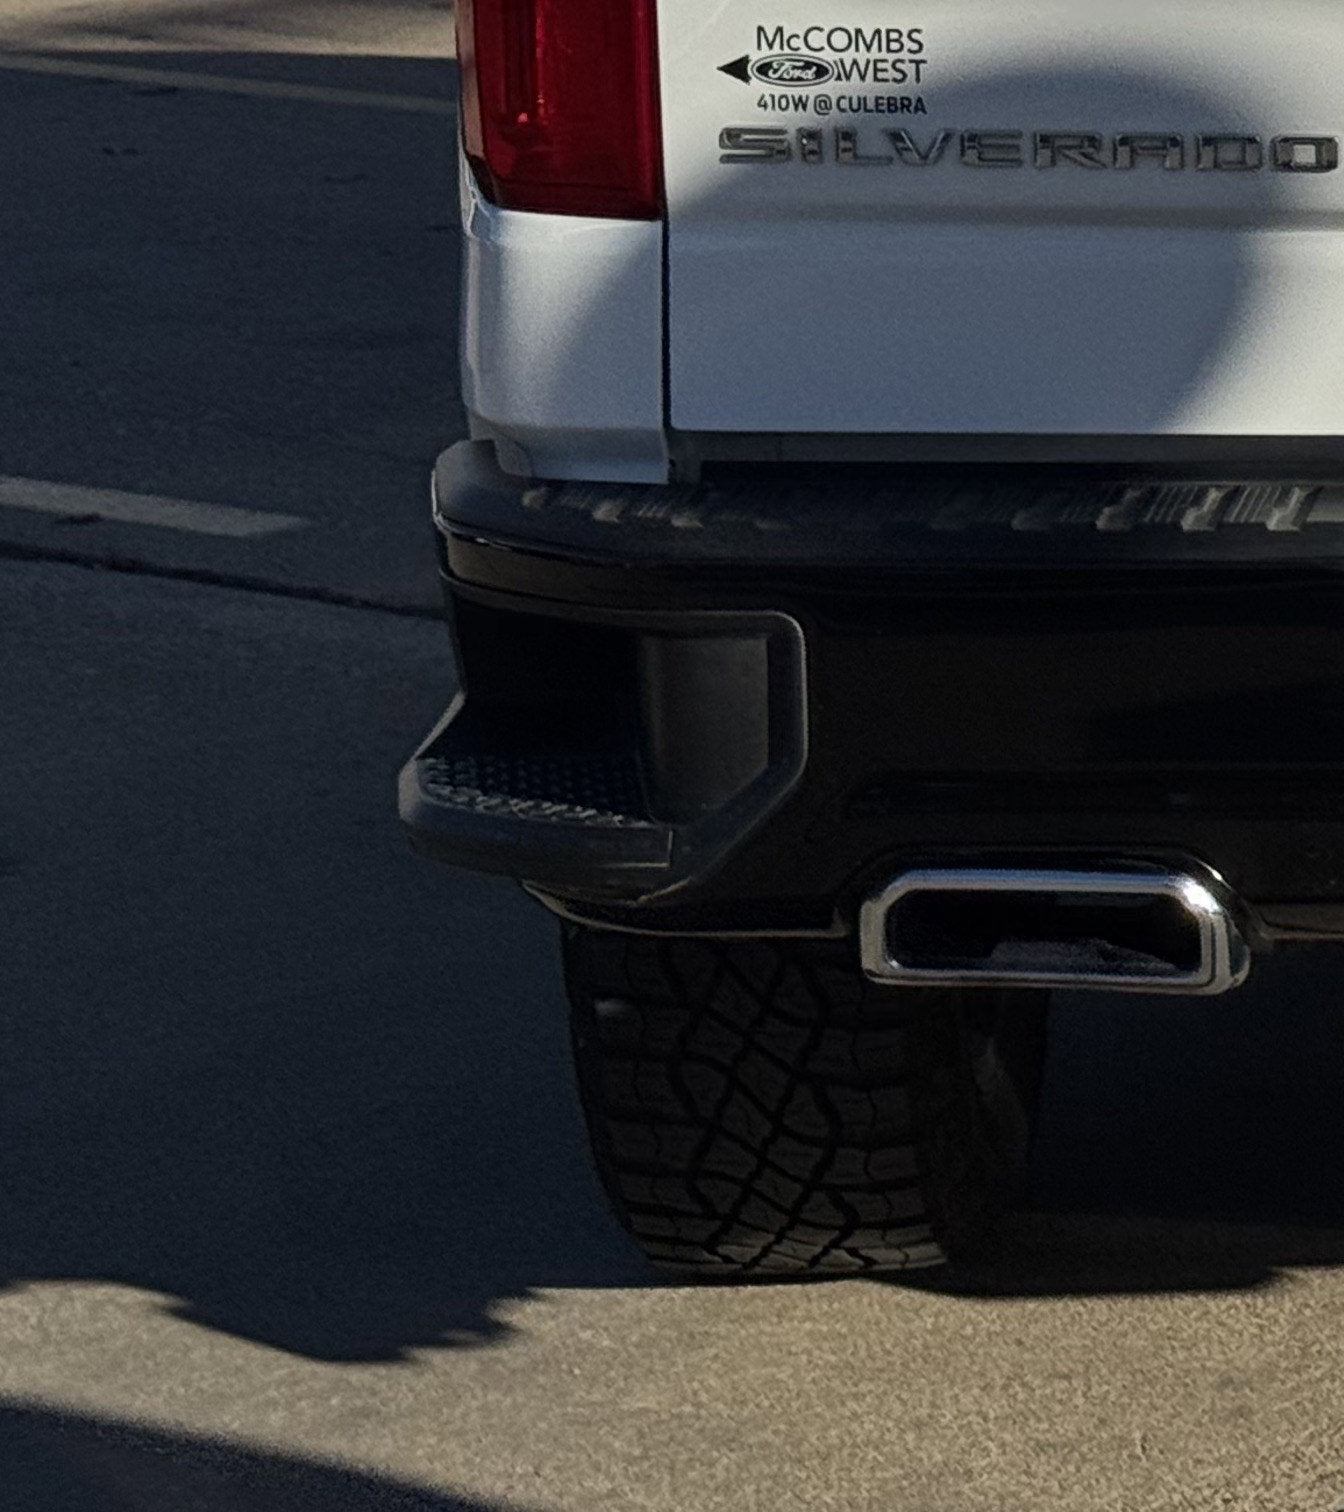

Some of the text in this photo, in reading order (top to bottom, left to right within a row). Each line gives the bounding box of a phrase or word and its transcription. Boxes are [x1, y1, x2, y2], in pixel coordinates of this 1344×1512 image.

[756, 25, 924, 55] McCOMBS
[769, 59, 816, 80] Ford
[757, 93, 928, 116] 410W @ CULEBRA
[718, 127, 1340, 174] SILVERADO
